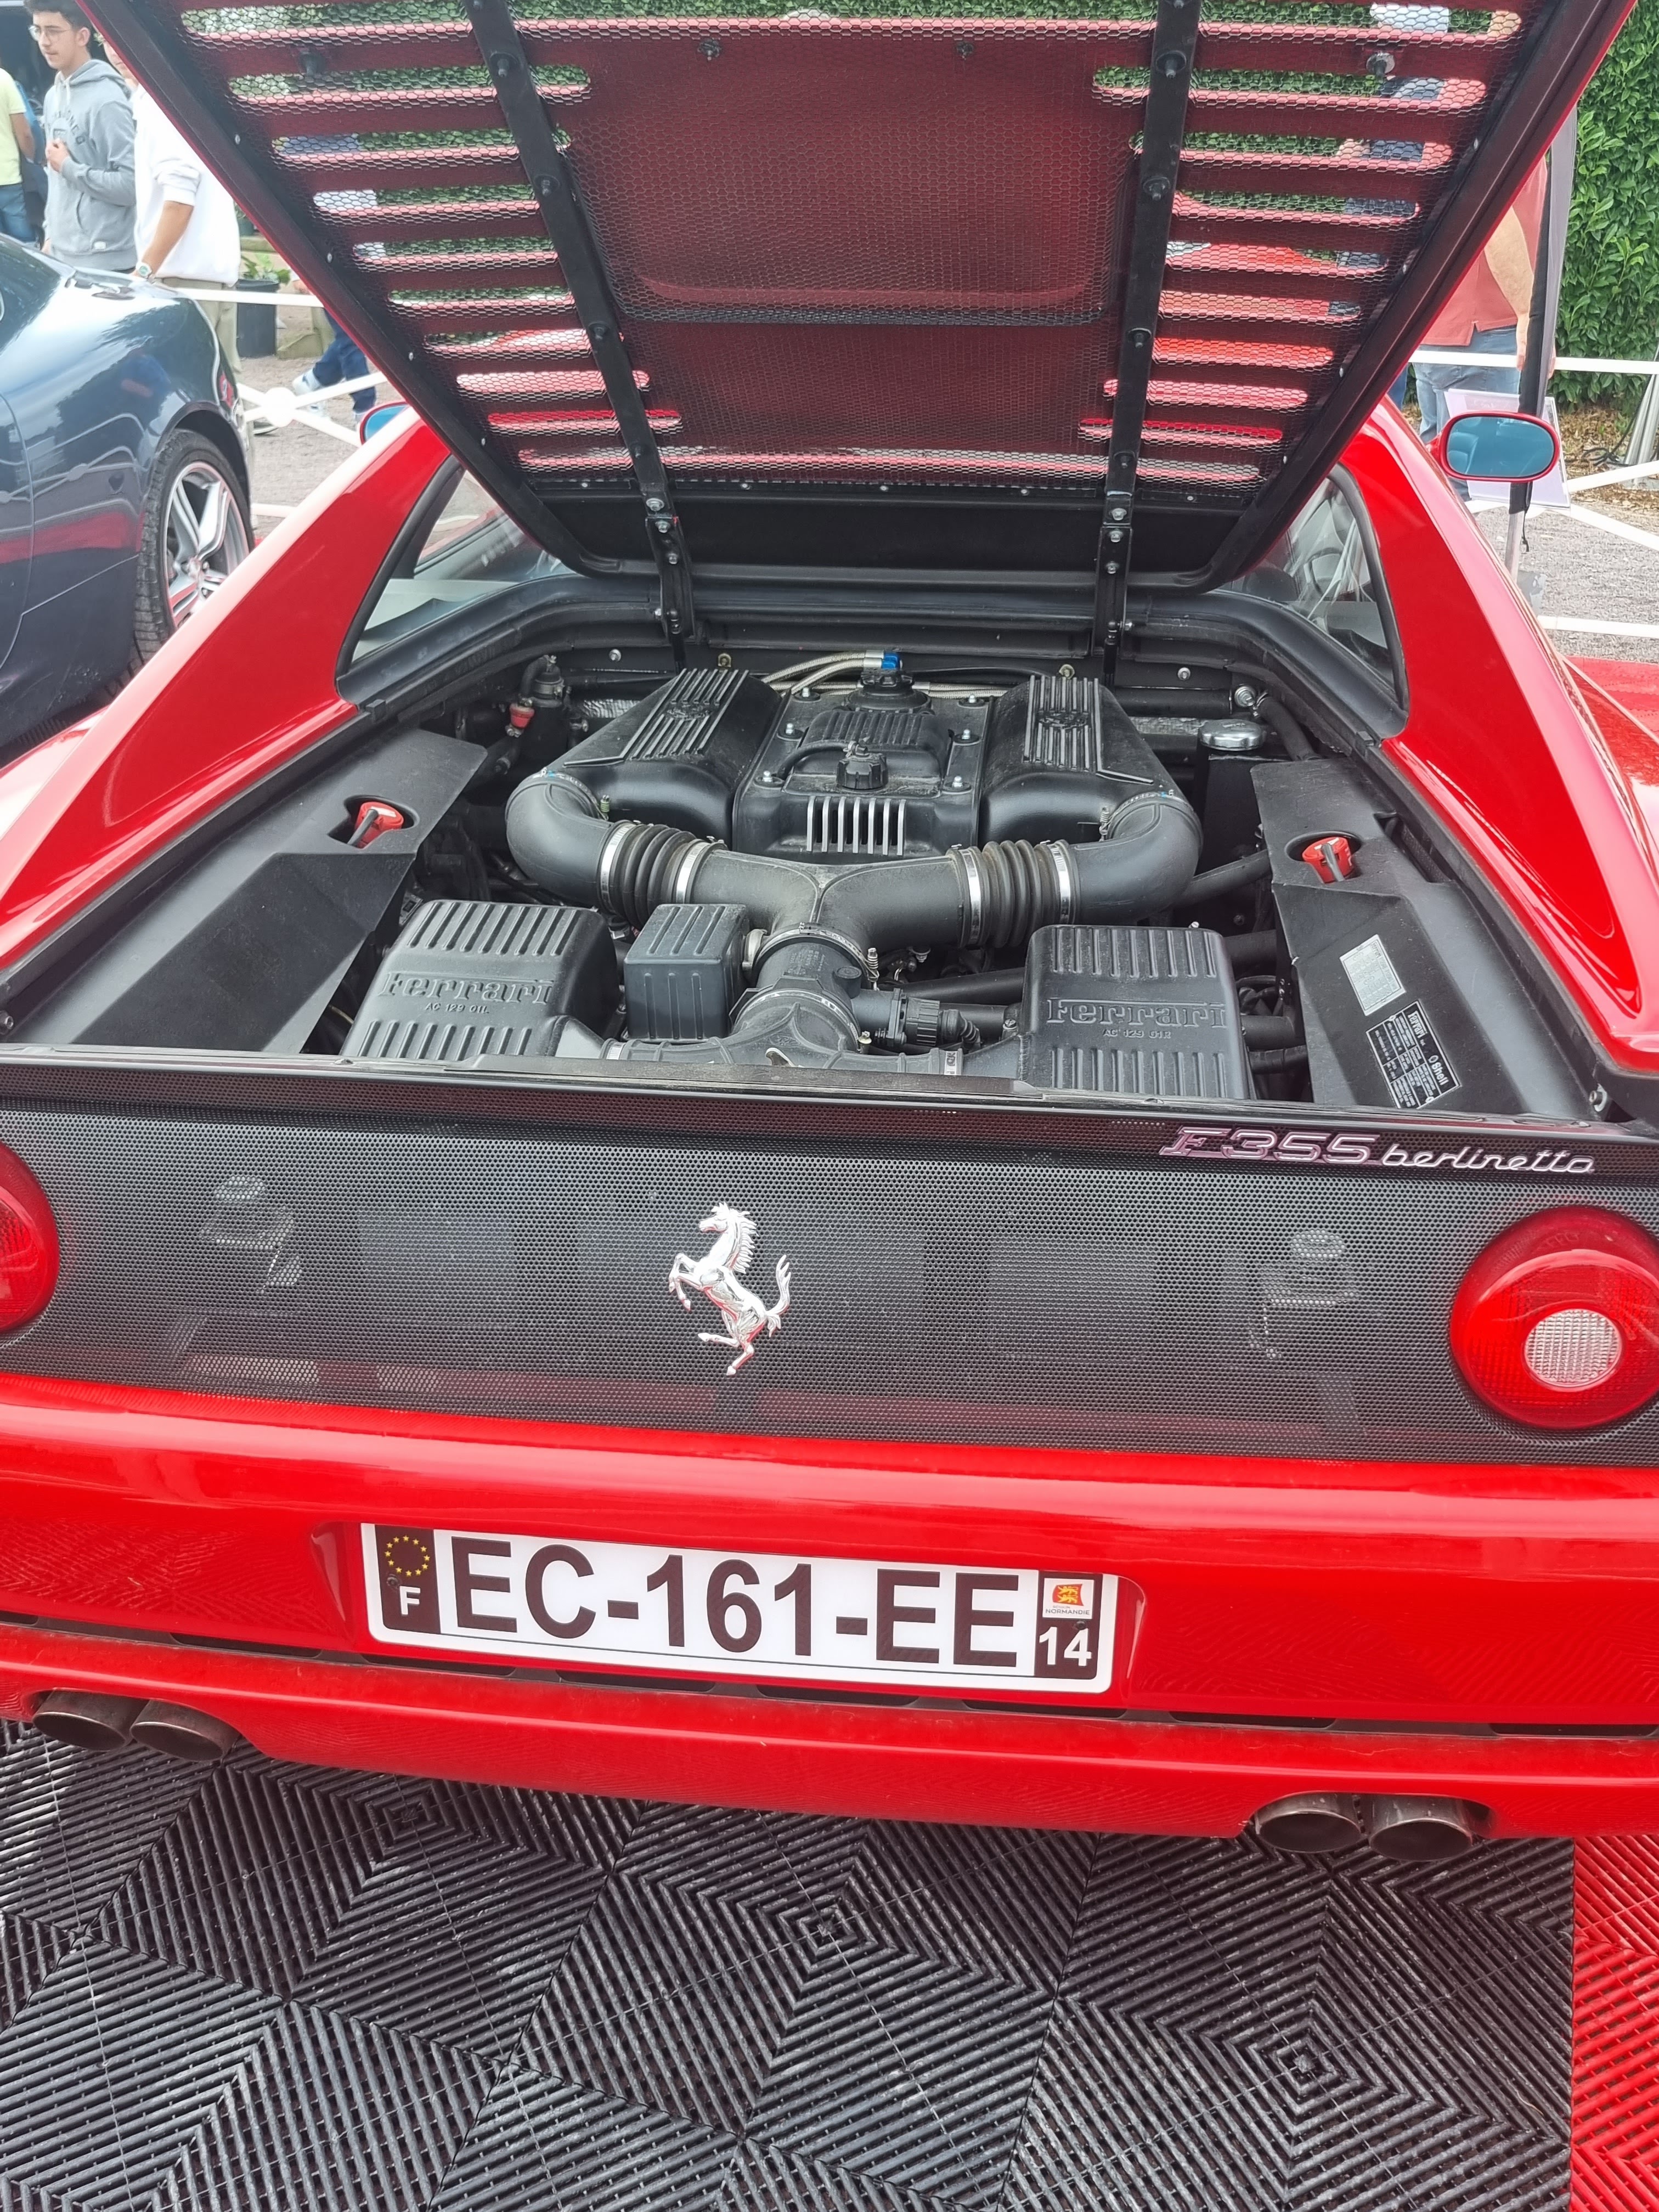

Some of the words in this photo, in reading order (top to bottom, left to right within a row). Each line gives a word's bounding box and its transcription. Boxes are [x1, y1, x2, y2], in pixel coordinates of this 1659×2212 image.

[379, 971, 554, 1005] Ferrari
[425, 1002, 441, 1011] AC
[445, 1003, 465, 1012] 129
[1046, 998, 1226, 1029] Ferrari
[1124, 1029, 1144, 1038] 129
[1408, 1011, 1428, 1039] Ferrari
[1431, 1062, 1449, 1086] Shell
[1159, 1126, 1380, 1164] F355
[1381, 1143, 1595, 1173] berlinetta
[399, 1585, 421, 1615] F
[451, 1536, 1019, 1667] EC-161-EE
[1039, 1627, 1092, 1666] 14
